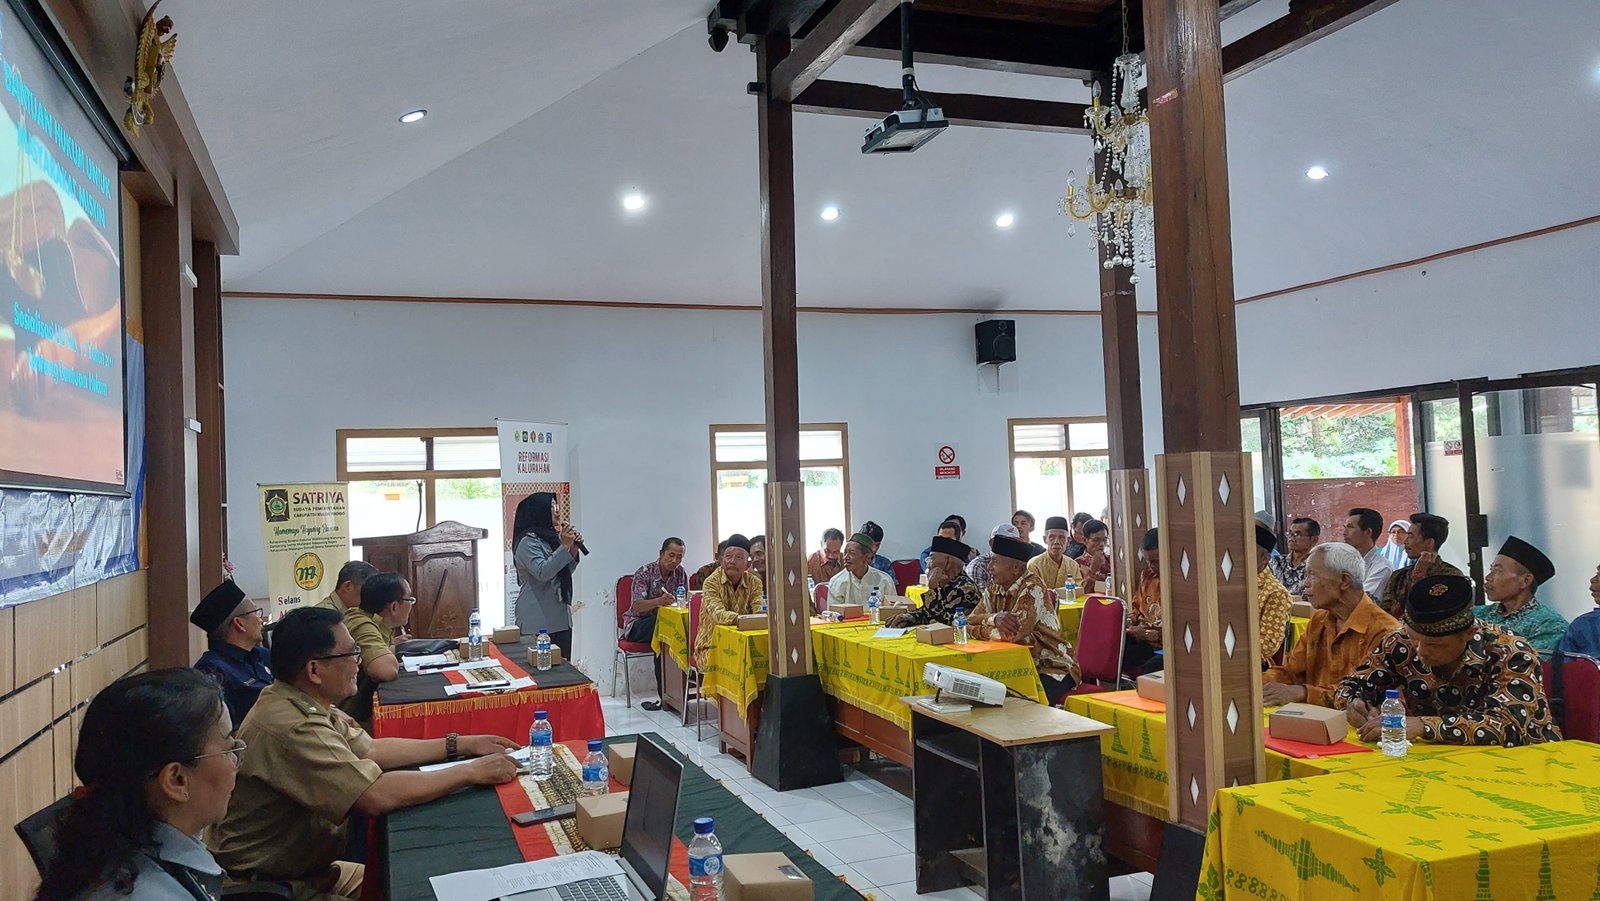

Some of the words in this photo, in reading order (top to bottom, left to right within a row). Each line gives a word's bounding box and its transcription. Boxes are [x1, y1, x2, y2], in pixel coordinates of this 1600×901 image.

[54, 119, 85, 173] HUKUM
[86, 154, 112, 201] UNTUK
[79, 184, 106, 229] MISKIN
[518, 451, 549, 463] REFORMASI
[517, 463, 550, 474] KALURAHAN
[293, 492, 344, 504] SATRIYA
